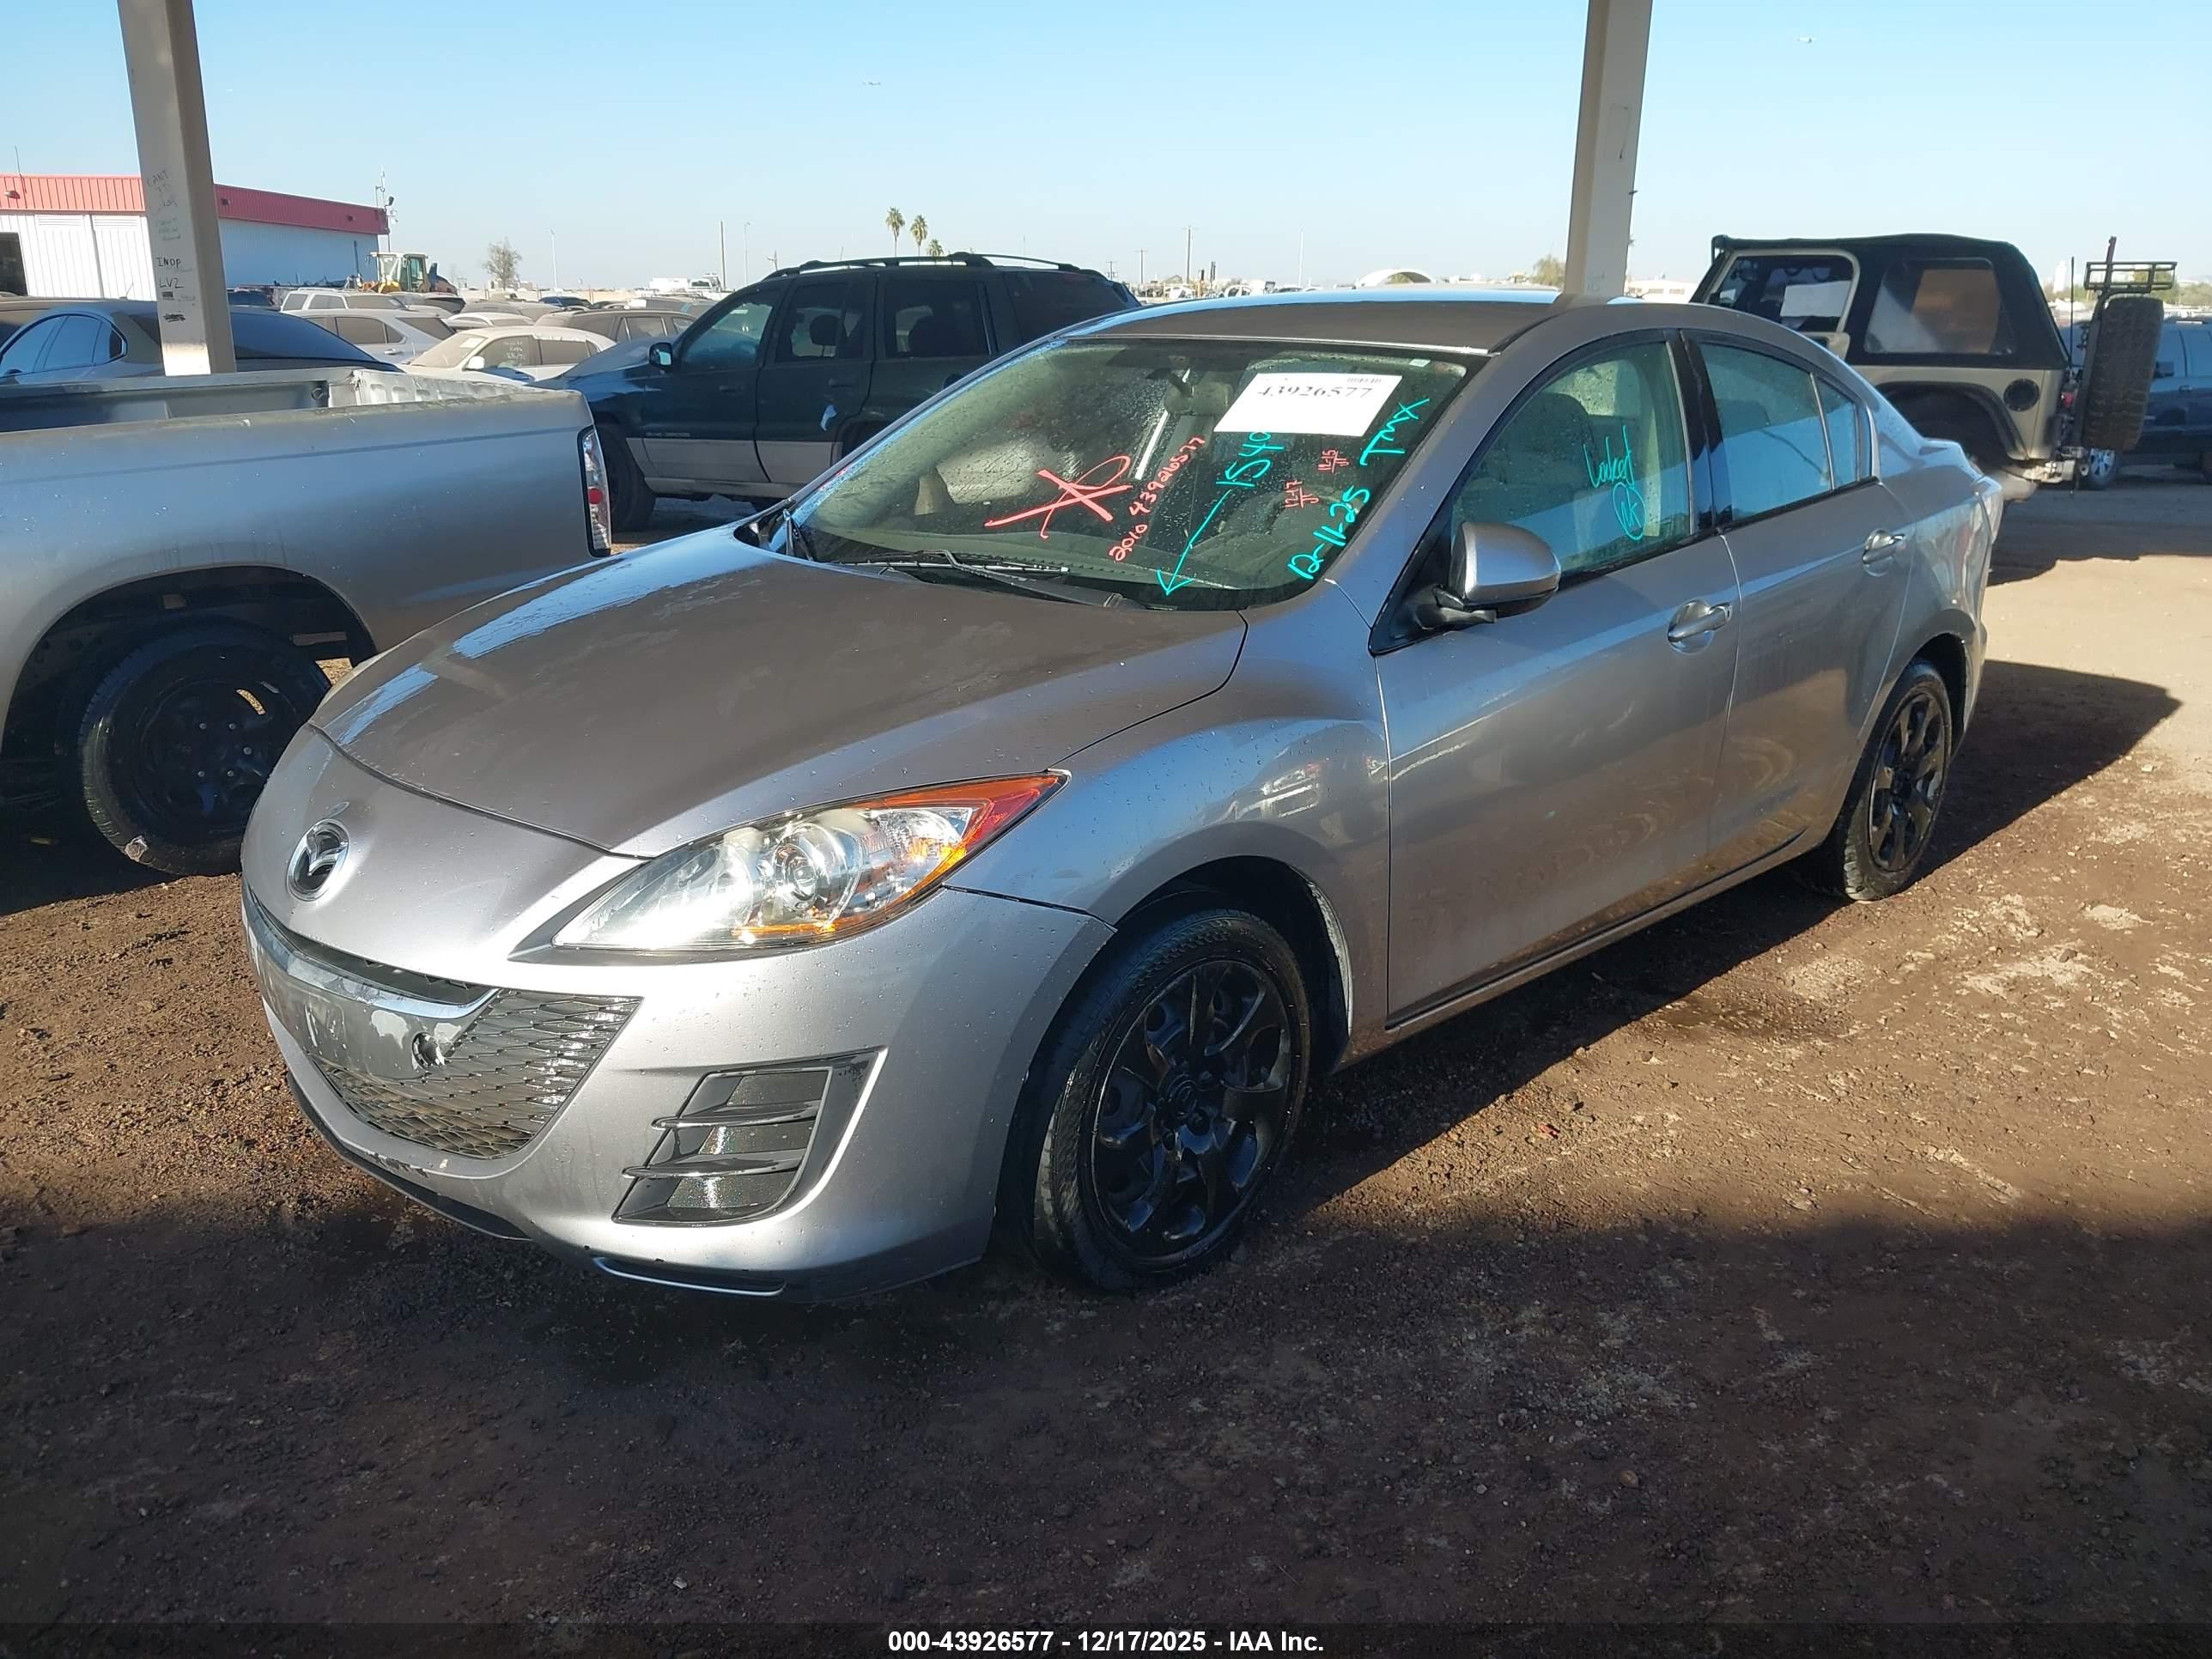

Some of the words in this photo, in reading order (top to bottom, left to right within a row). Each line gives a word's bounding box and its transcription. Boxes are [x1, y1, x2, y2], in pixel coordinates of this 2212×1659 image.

[1258, 386, 1374, 398] 43926577
[1108, 524, 1148, 562] 2010
[1128, 436, 1206, 516] 43926577
